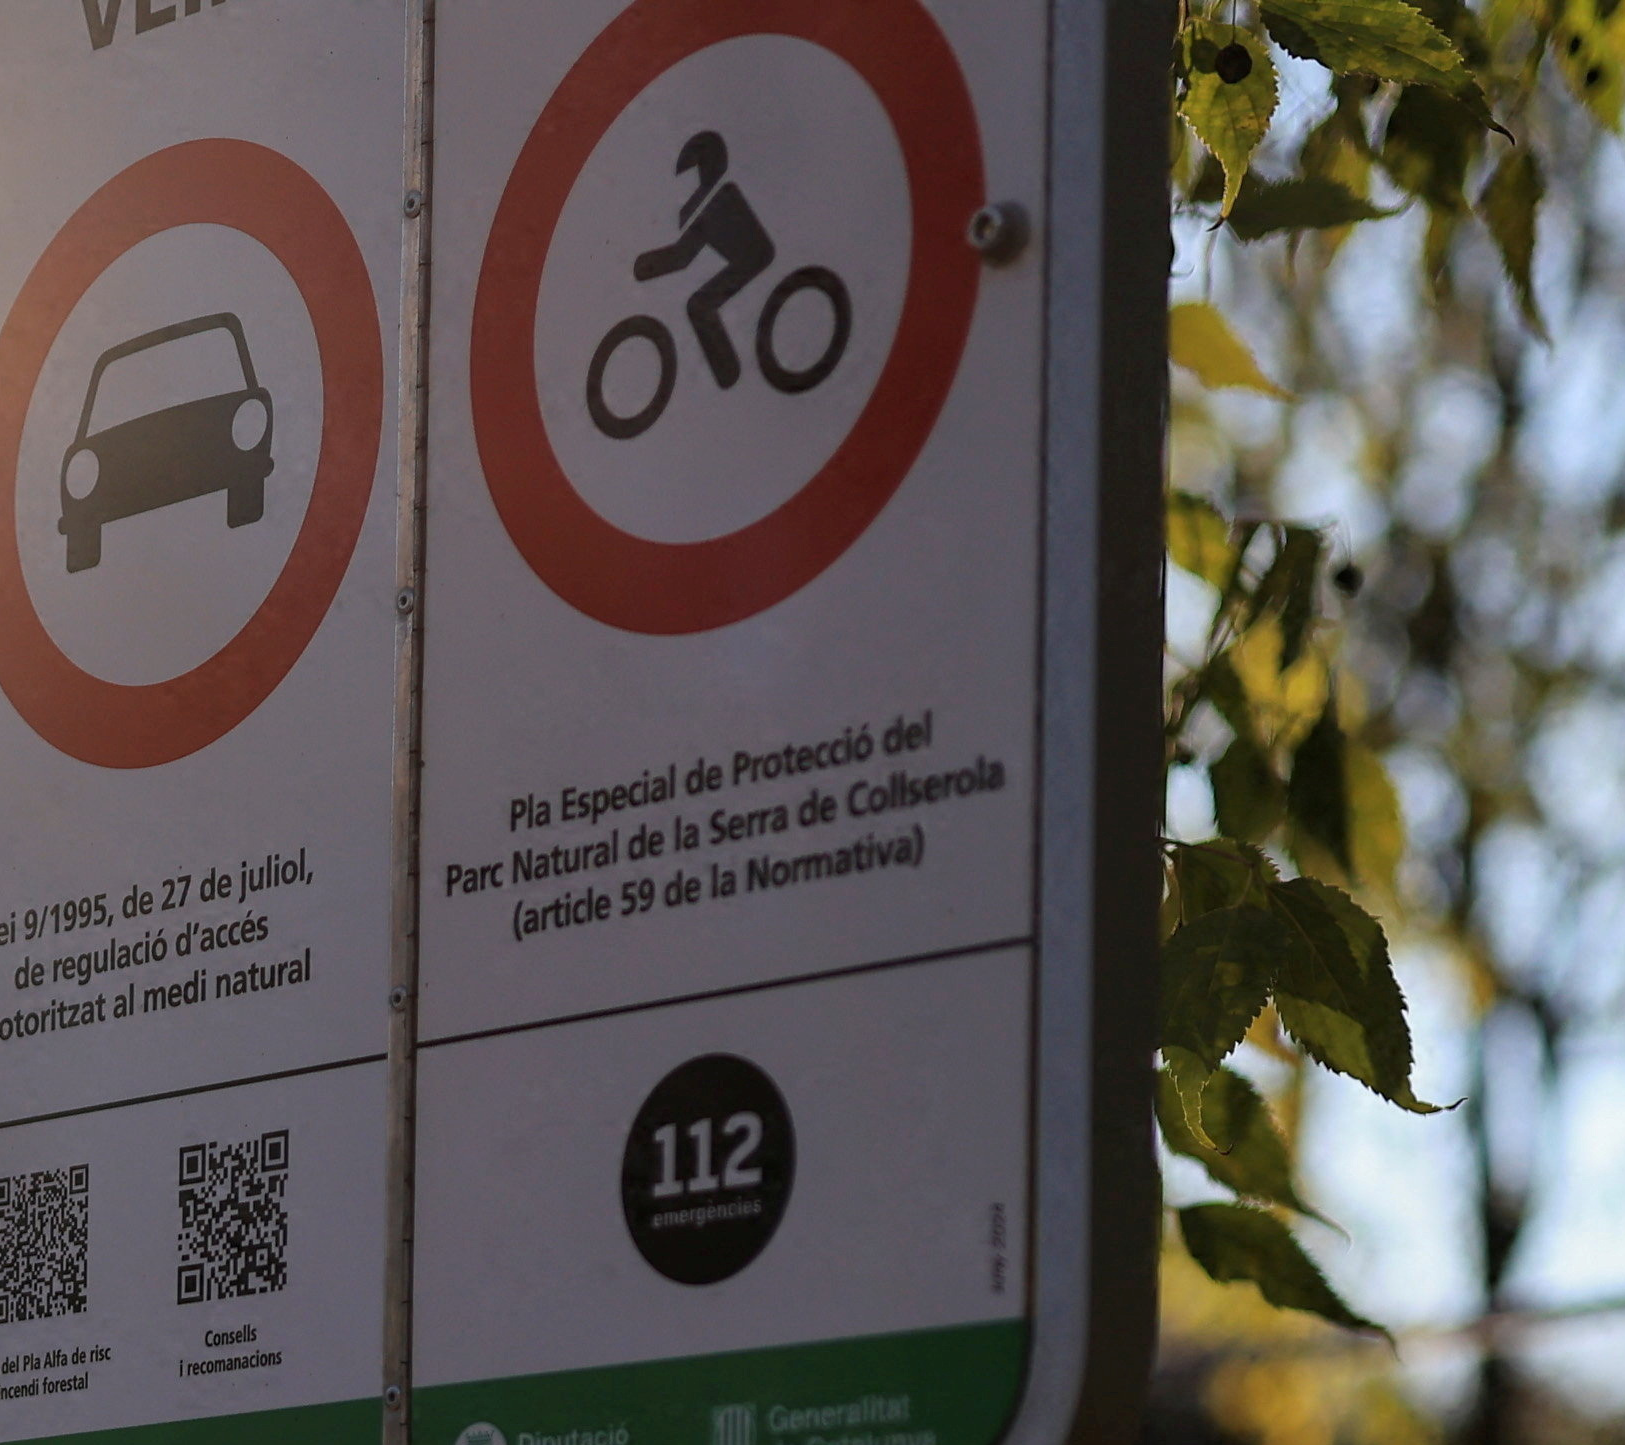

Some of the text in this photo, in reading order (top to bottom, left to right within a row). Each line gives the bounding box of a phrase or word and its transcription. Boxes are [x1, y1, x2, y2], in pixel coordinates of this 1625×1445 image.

[510, 710, 933, 832] Pla Especial de Protecció del
[446, 755, 1006, 897] Parc Natural de la Serra de Collserola
[24, 894, 113, 940] 9/1995,
[123, 885, 153, 919] de
[161, 875, 191, 911] 27
[200, 867, 231, 902] de
[239, 848, 314, 903] juliol,
[513, 824, 926, 941] (article 59 de la Normativa)
[15, 957, 44, 989] de
[53, 929, 167, 985] regulació
[113, 984, 134, 1018] al
[144, 970, 206, 1012] medi
[215, 948, 311, 998] natural
[654, 1110, 763, 1197] 112
[2, 1355, 20, 1376] del
[23, 1353, 41, 1373] Pla
[44, 1348, 68, 1370] Alfa
[71, 1346, 86, 1365] de
[90, 1345, 111, 1362] risc
[179, 1349, 282, 1377] i recomanacions
[204, 1325, 257, 1348] Consells
[42, 1372, 88, 1394] forestal
[767, 1395, 910, 1433] Generalitat
